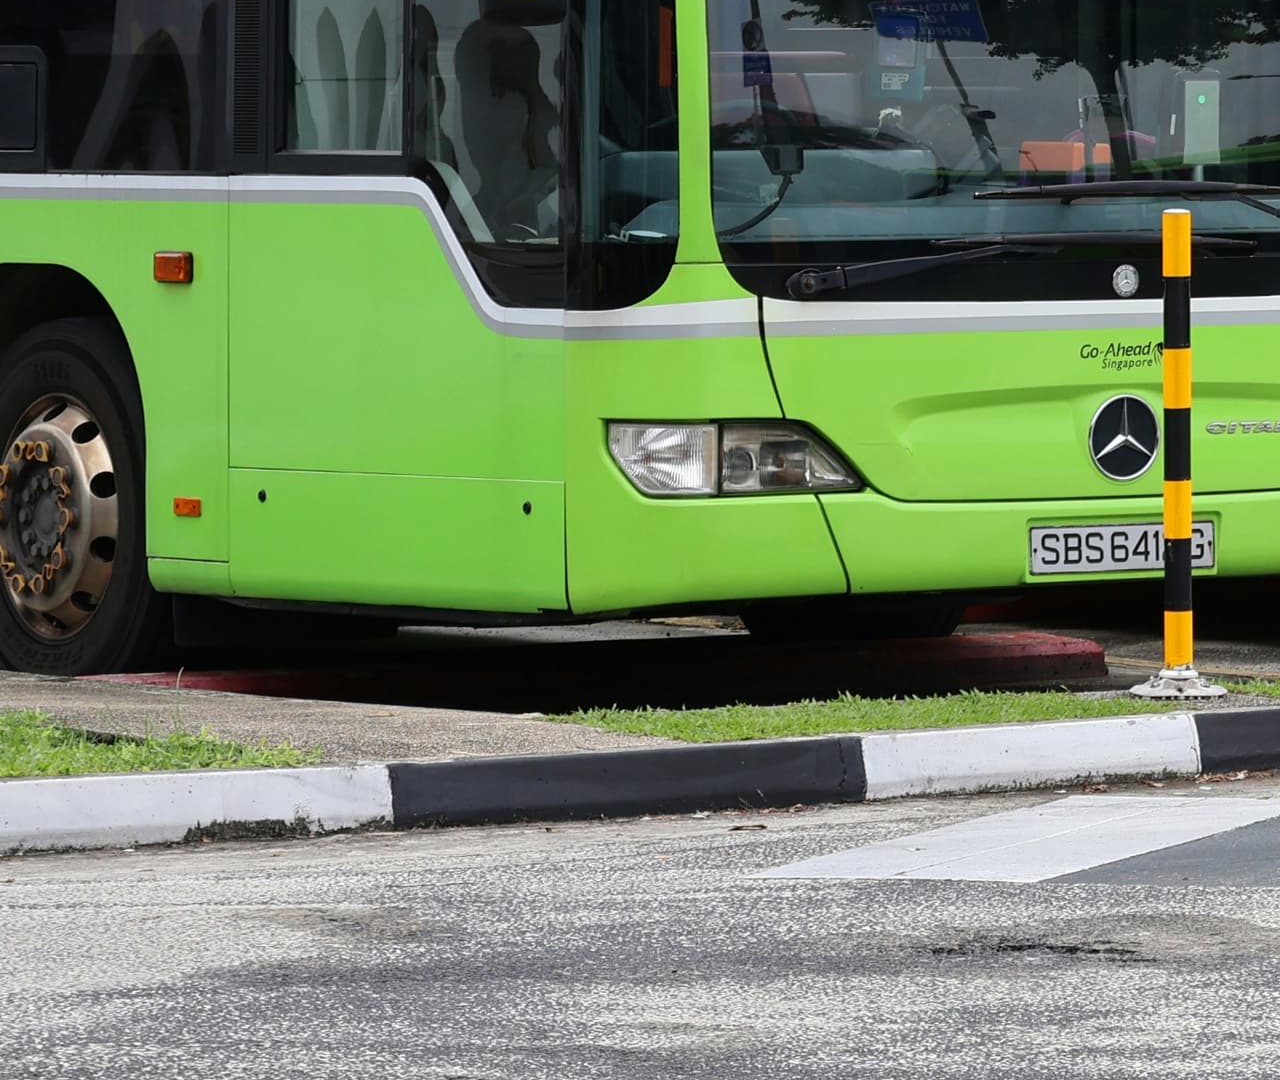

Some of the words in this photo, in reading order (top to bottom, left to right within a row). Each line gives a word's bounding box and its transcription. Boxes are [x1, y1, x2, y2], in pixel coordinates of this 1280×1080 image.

[1080, 341, 1152, 359] Go-Ahead
[1101, 359, 1153, 371] Singapore
[1041, 529, 1204, 565] SBS641G
